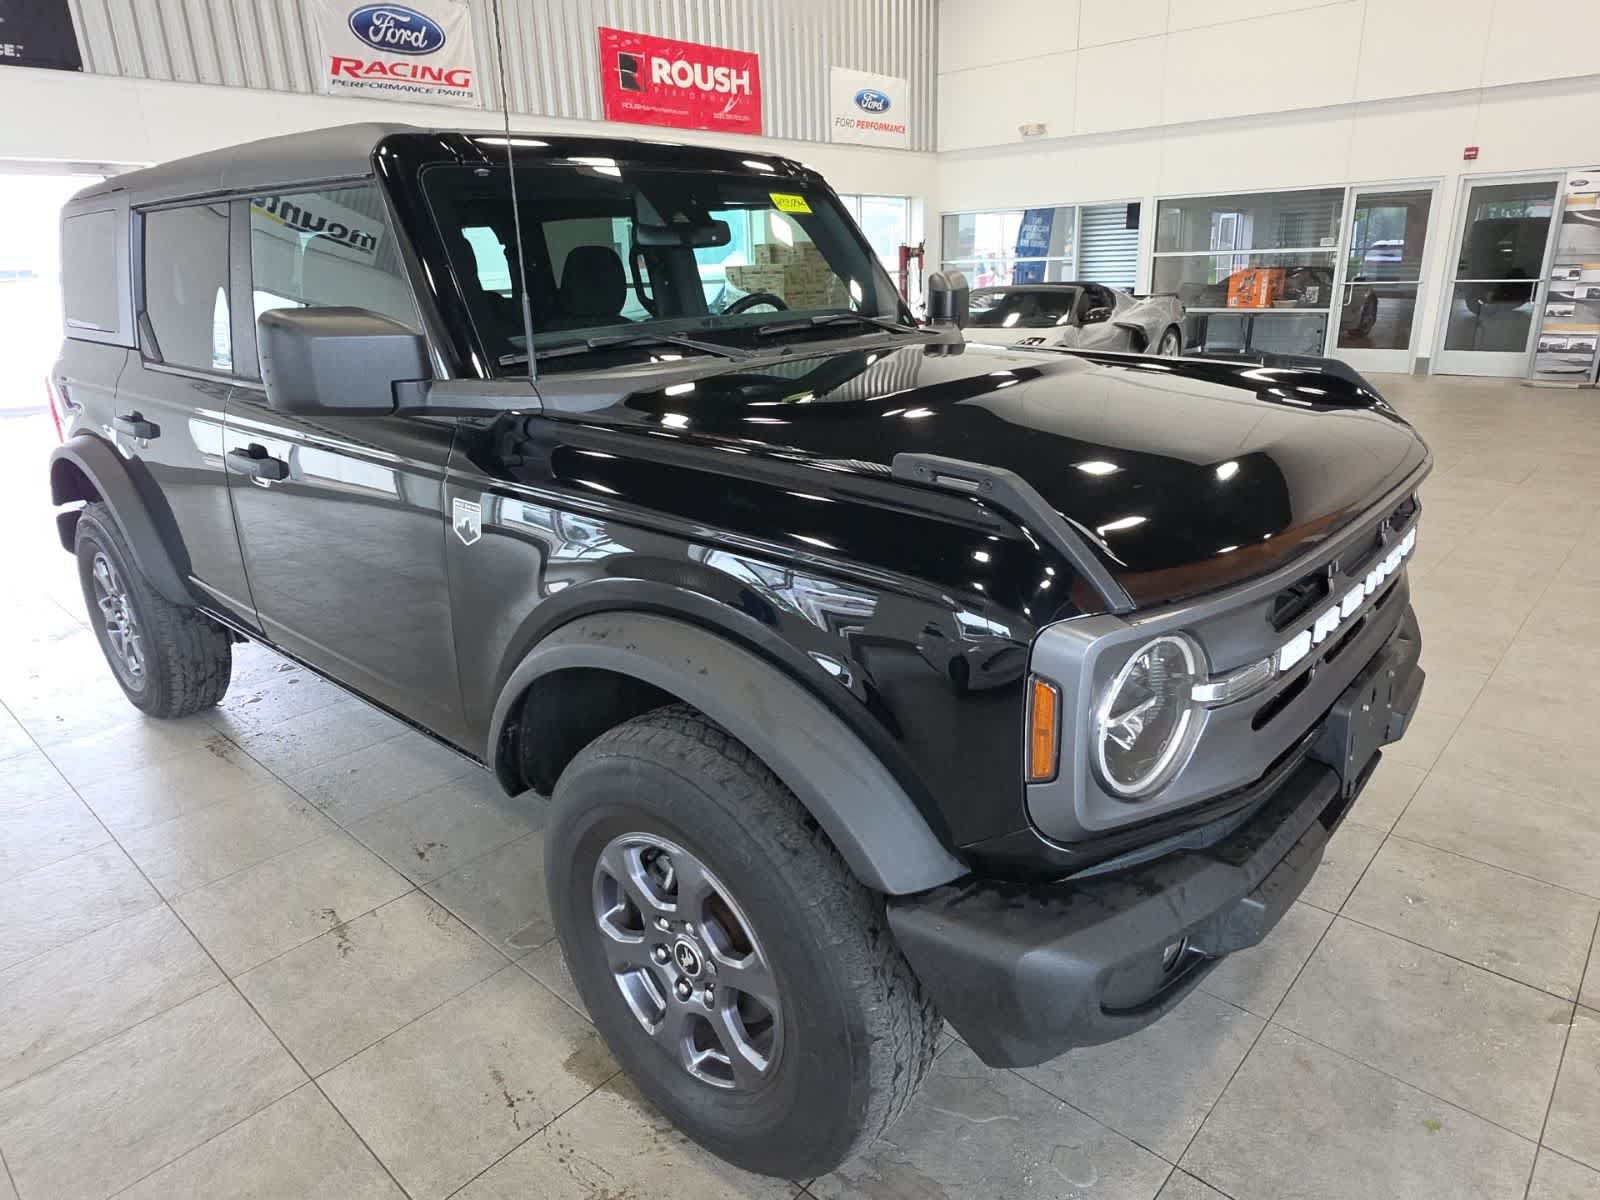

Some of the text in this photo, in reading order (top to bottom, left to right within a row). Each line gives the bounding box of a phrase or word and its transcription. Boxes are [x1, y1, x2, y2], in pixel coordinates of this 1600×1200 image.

[369, 11, 428, 48] Ford
[331, 56, 472, 88] RACING
[651, 56, 751, 95] ROUSH
[332, 79, 474, 98] PERFORMANCE PARTS
[861, 92, 884, 110] Ford
[835, 117, 906, 134] FORD PERFORMANCE
